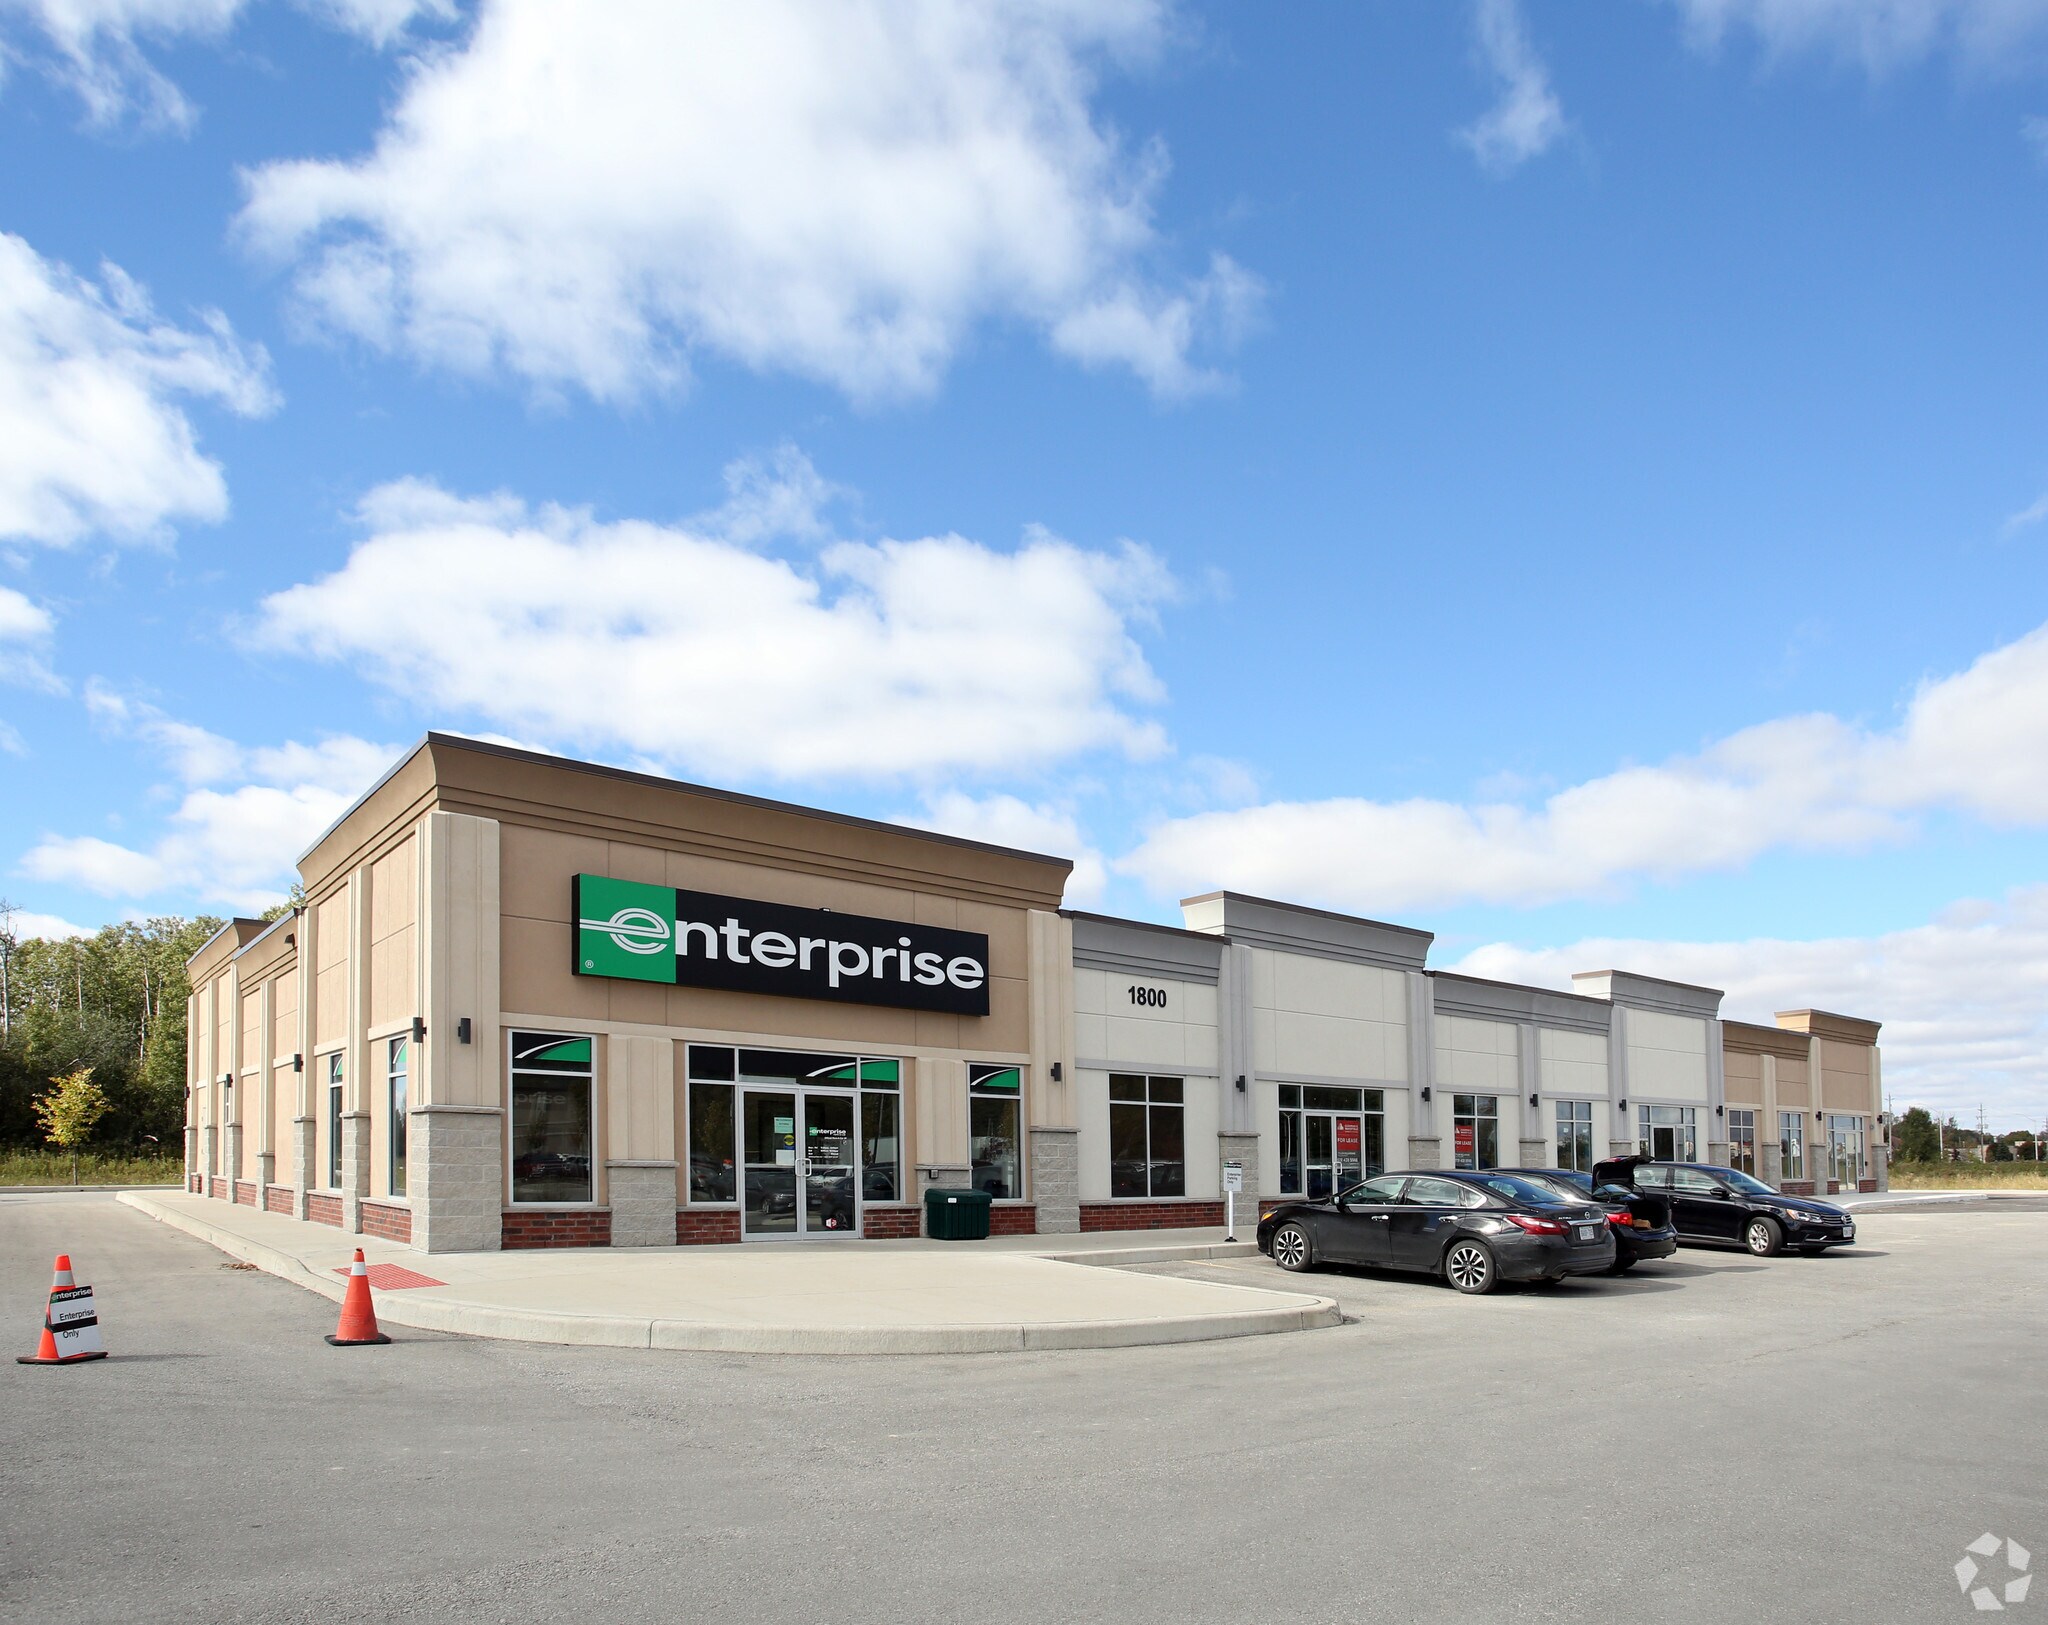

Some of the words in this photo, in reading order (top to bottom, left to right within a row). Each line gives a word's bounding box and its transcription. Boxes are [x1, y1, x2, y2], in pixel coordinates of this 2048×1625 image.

[580, 907, 985, 989] enterprise
[1128, 985, 1167, 1008] 1800
[52, 1288, 92, 1301] enterprise
[60, 1309, 95, 1321] Enterprise
[62, 1329, 80, 1339] Only
